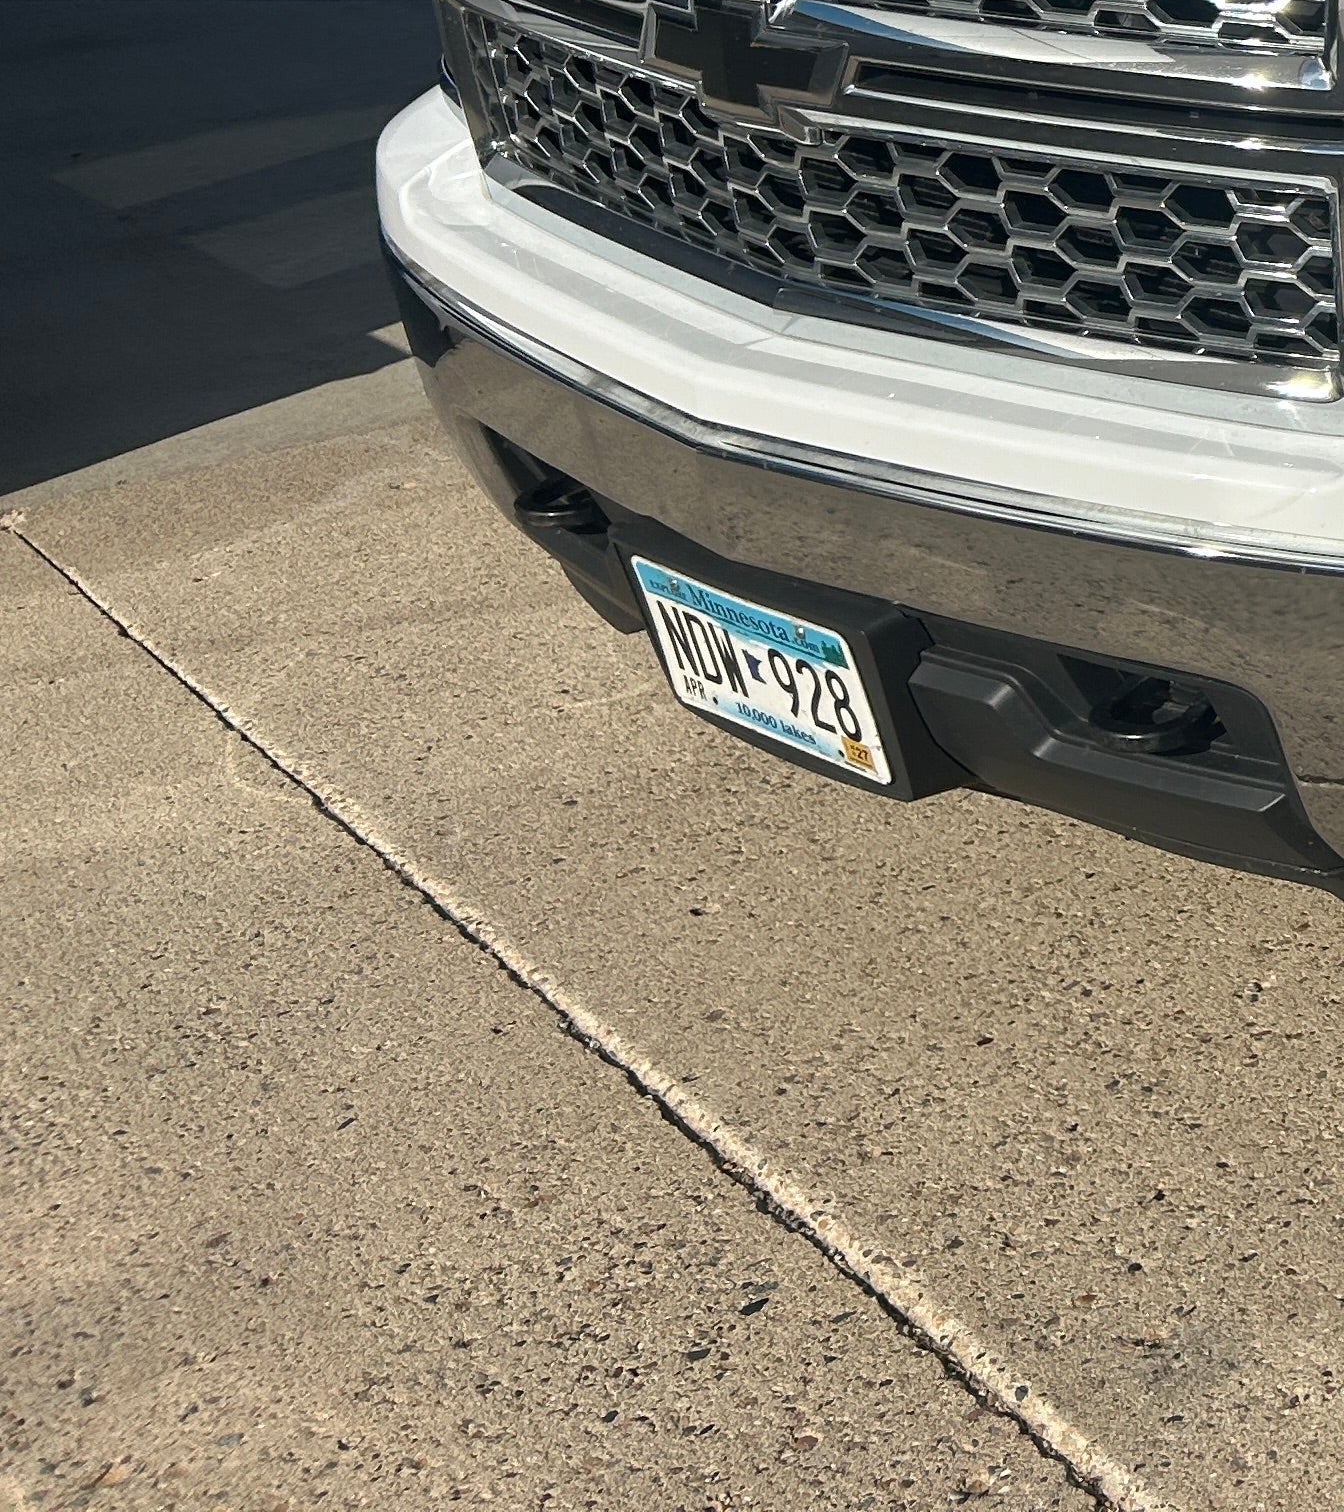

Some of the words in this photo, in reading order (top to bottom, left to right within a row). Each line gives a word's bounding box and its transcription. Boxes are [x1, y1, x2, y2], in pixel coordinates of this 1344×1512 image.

[656, 600, 750, 699] NDW
[766, 647, 863, 743] 928
[683, 674, 707, 701] APR
[780, 719, 817, 745] lakes
